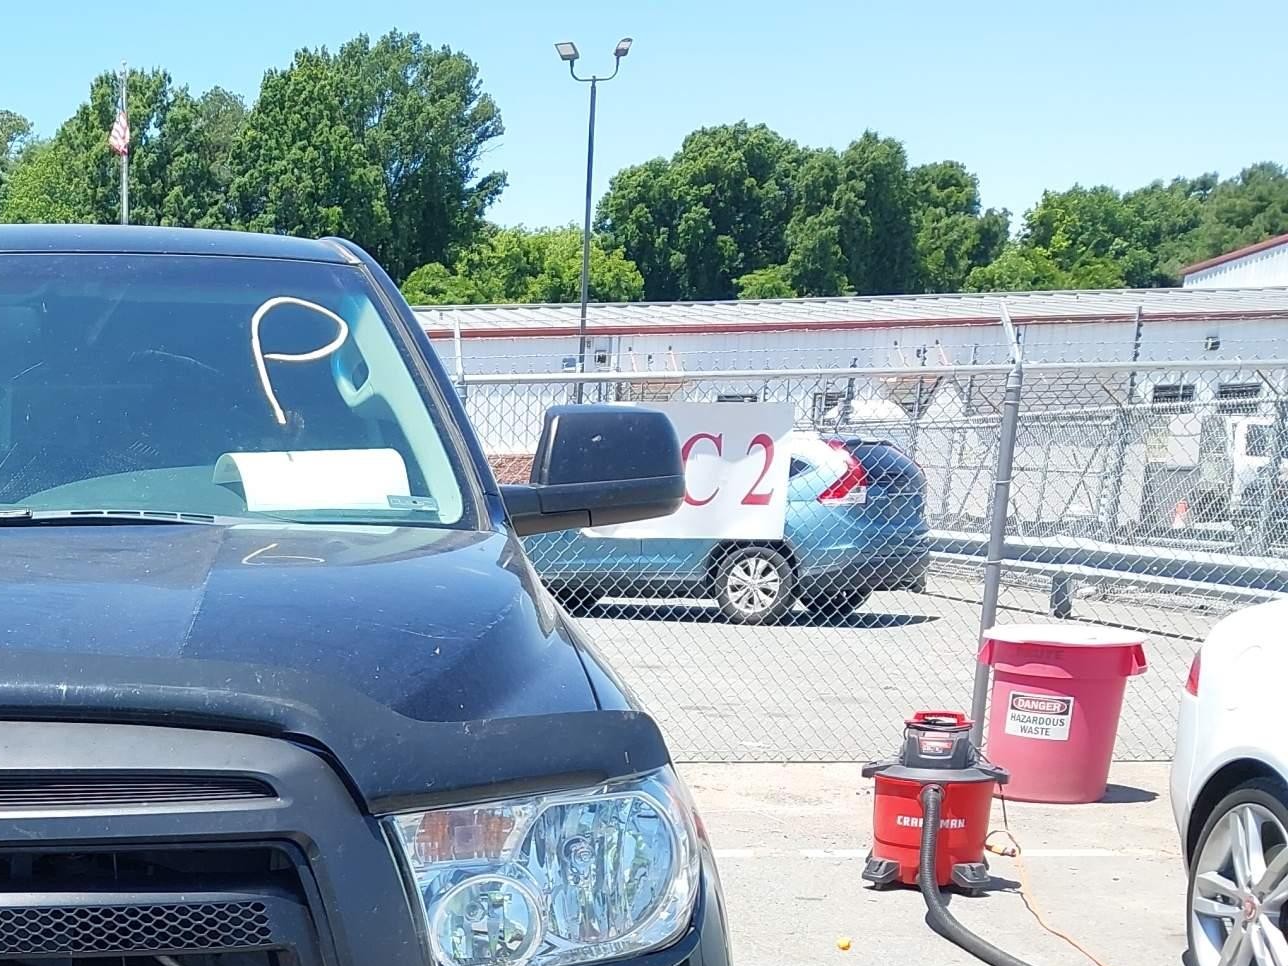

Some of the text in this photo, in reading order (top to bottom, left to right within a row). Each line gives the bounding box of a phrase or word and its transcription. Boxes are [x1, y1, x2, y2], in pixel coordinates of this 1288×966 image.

[252, 296, 348, 424] P
[741, 433, 774, 505] 2
[1017, 699, 1062, 712] DANGER
[1010, 712, 1065, 727] HAZARDOUS
[1020, 725, 1051, 737] WASTE
